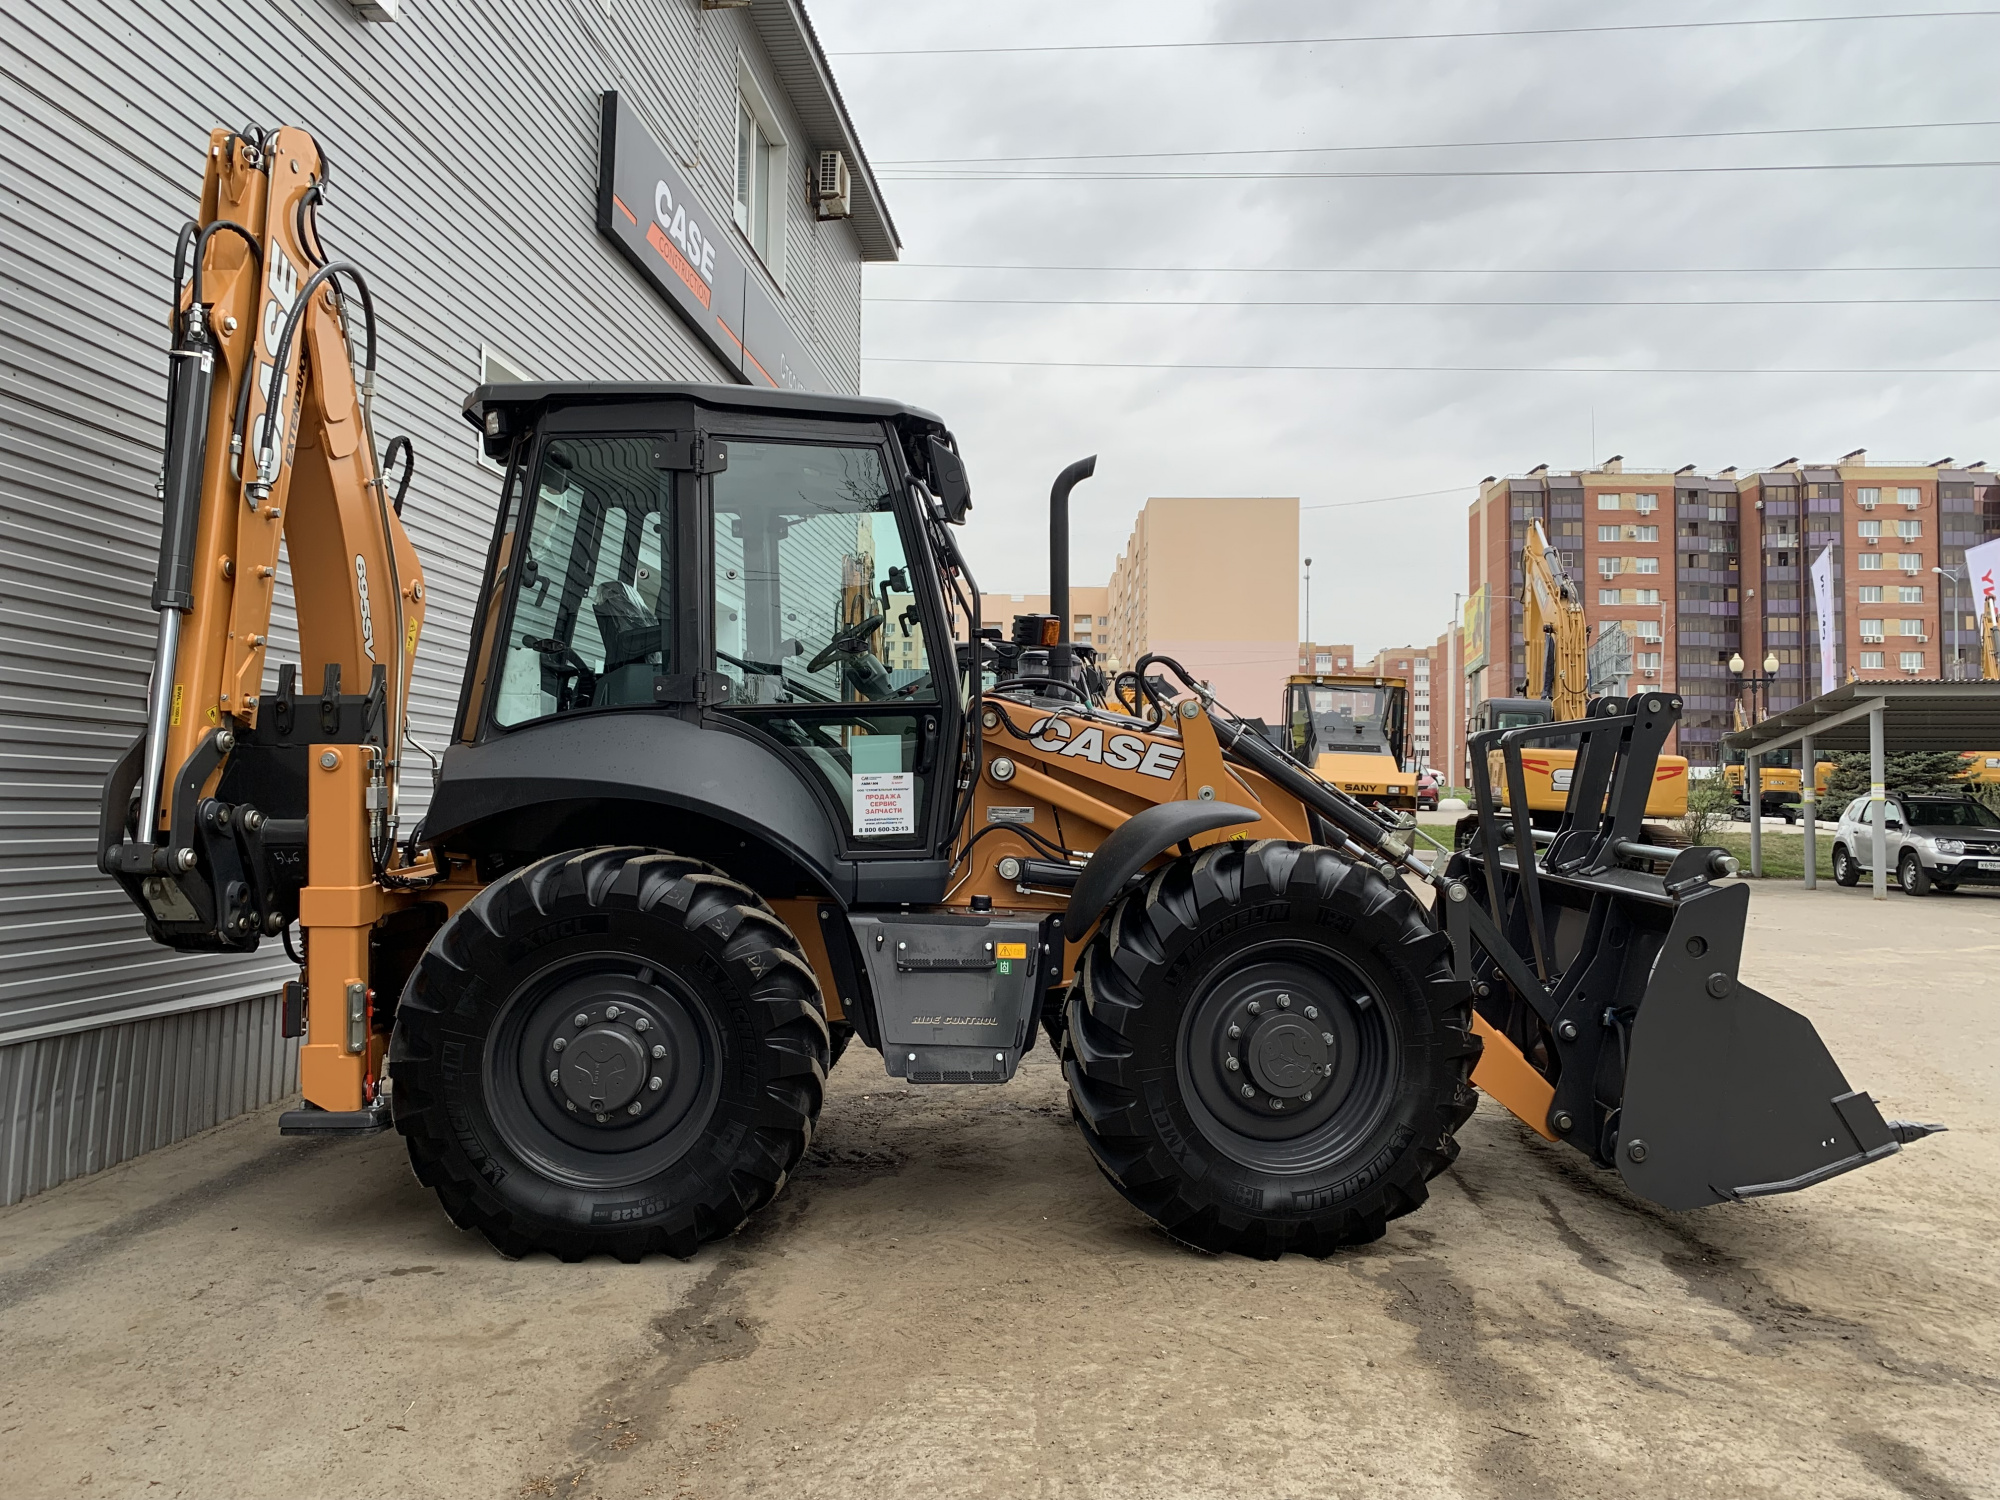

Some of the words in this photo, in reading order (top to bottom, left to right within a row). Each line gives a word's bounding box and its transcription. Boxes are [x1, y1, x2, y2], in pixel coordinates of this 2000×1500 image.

[655, 179, 716, 285] CASE
[658, 236, 710, 305] CONSTRUCTION
[355, 554, 376, 663] 695SV
[1028, 717, 1185, 781] CASE
[1344, 784, 1377, 792] SANY
[273, 851, 300, 865] 546
[1187, 904, 1288, 961] MICHELIN
[911, 1016, 942, 1024] RIDE
[943, 1016, 998, 1026] CONTROL
[1150, 1100, 1191, 1165] XMCL
[1296, 1148, 1395, 1211] MICHELIN
[610, 1204, 641, 1221] R28
